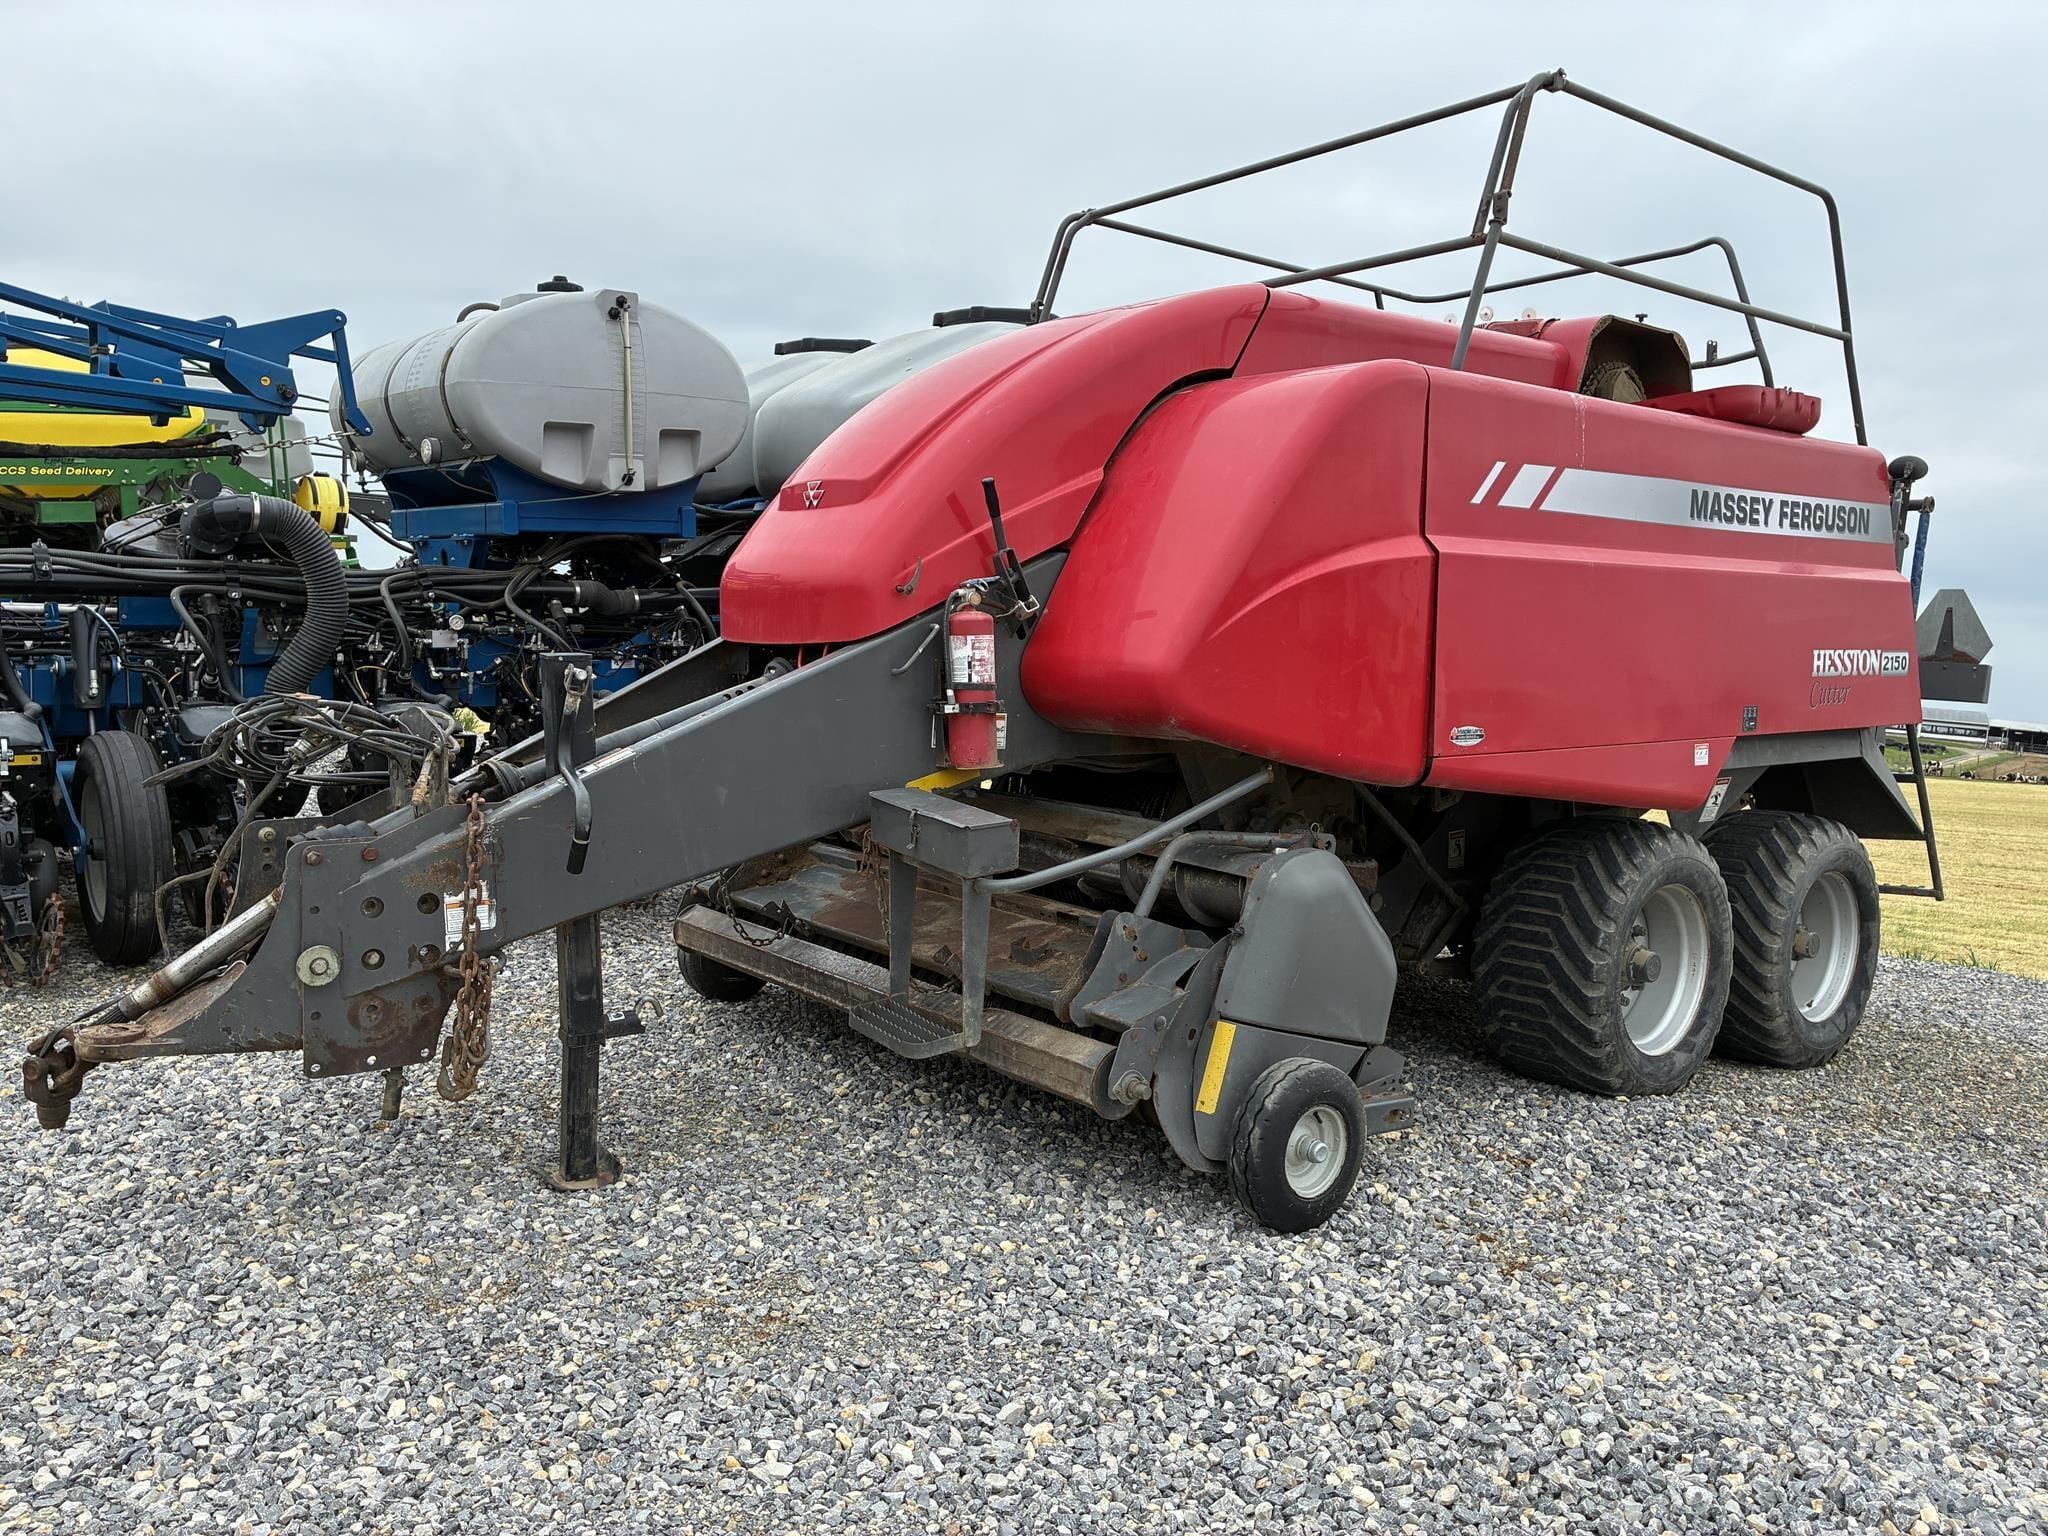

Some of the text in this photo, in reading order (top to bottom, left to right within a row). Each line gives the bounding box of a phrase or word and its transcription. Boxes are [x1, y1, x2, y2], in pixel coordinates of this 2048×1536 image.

[0, 466, 114, 477] CCS Seed Delivery
[1690, 489, 1870, 534] MASSEY FERGUSON
[1811, 649, 1907, 677] HESSTON 2150
[1810, 681, 1851, 709] Cutter
